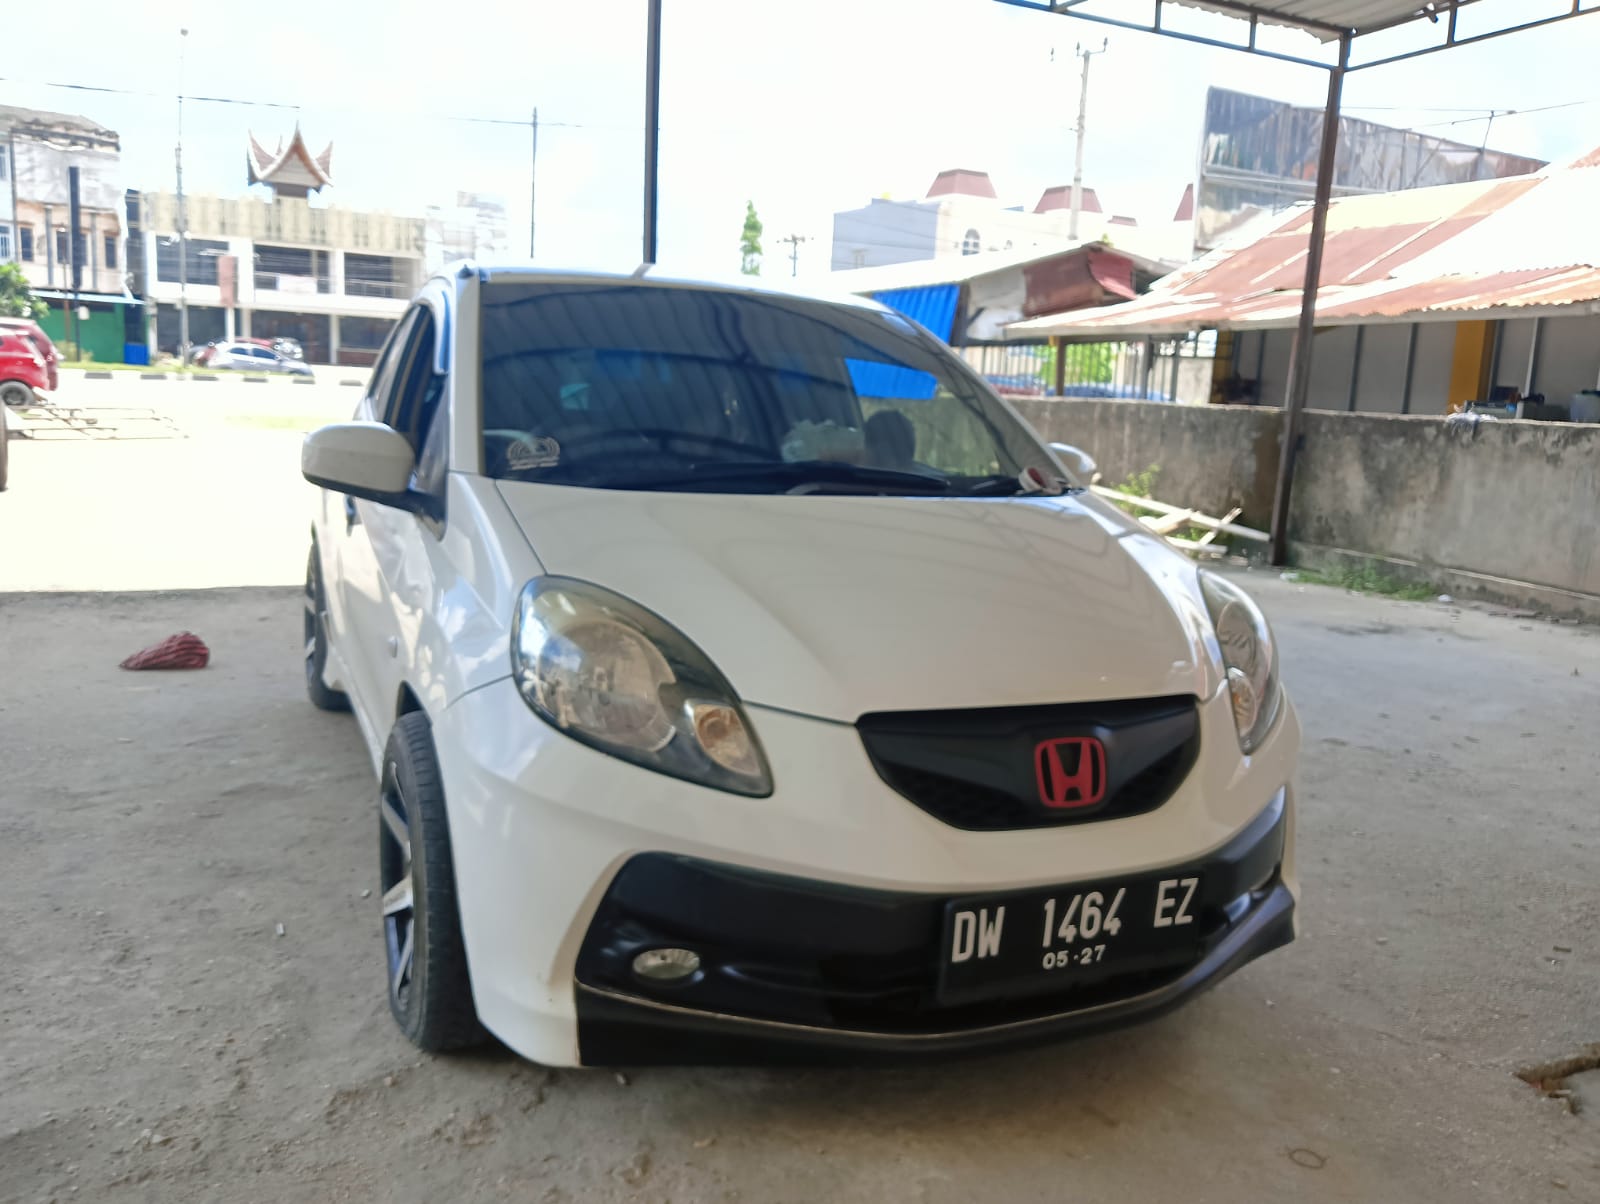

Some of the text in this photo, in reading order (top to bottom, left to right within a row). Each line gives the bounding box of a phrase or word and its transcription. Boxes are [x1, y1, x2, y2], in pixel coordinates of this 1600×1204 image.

[951, 877, 1199, 963] DW 1464 EZ
